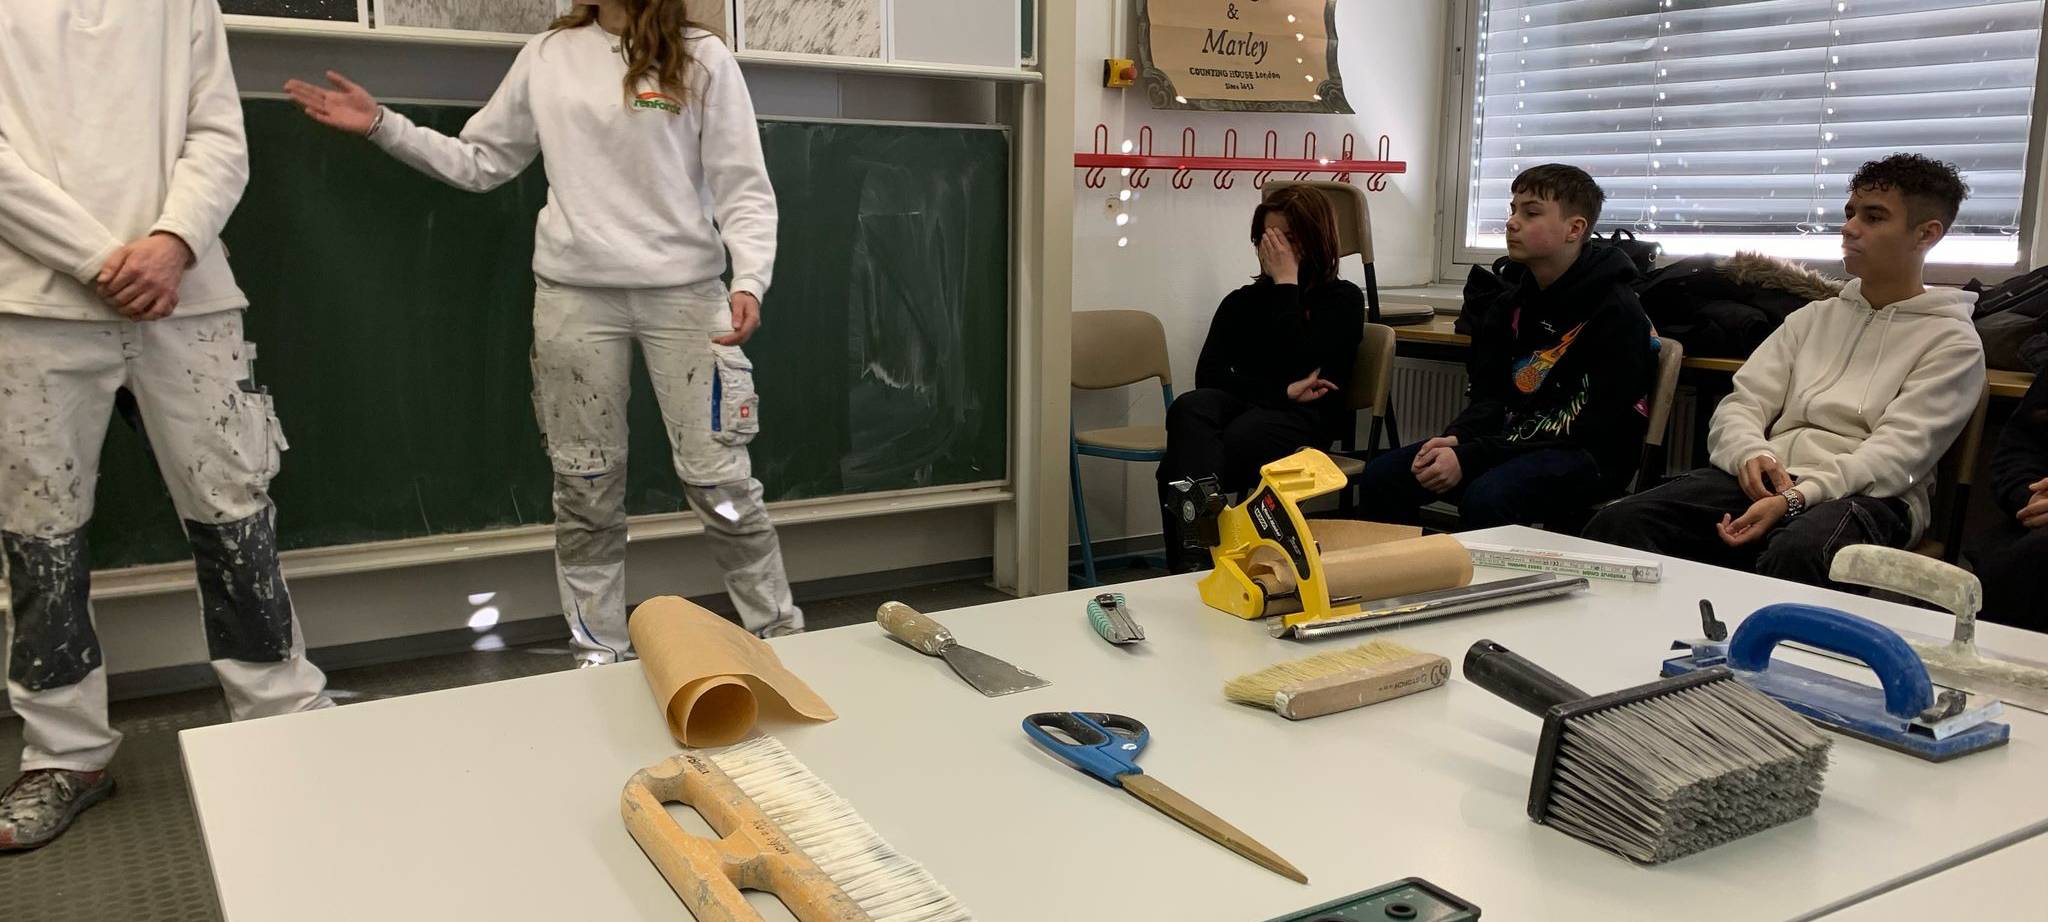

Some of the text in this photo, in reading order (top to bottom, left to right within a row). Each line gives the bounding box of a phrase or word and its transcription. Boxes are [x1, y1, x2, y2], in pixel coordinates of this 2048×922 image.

[1227, 3, 1239, 20] &
[1202, 28, 1269, 65] Marley
[1189, 67, 1228, 78] COUNTING
[1229, 70, 1254, 79] HOUSE
